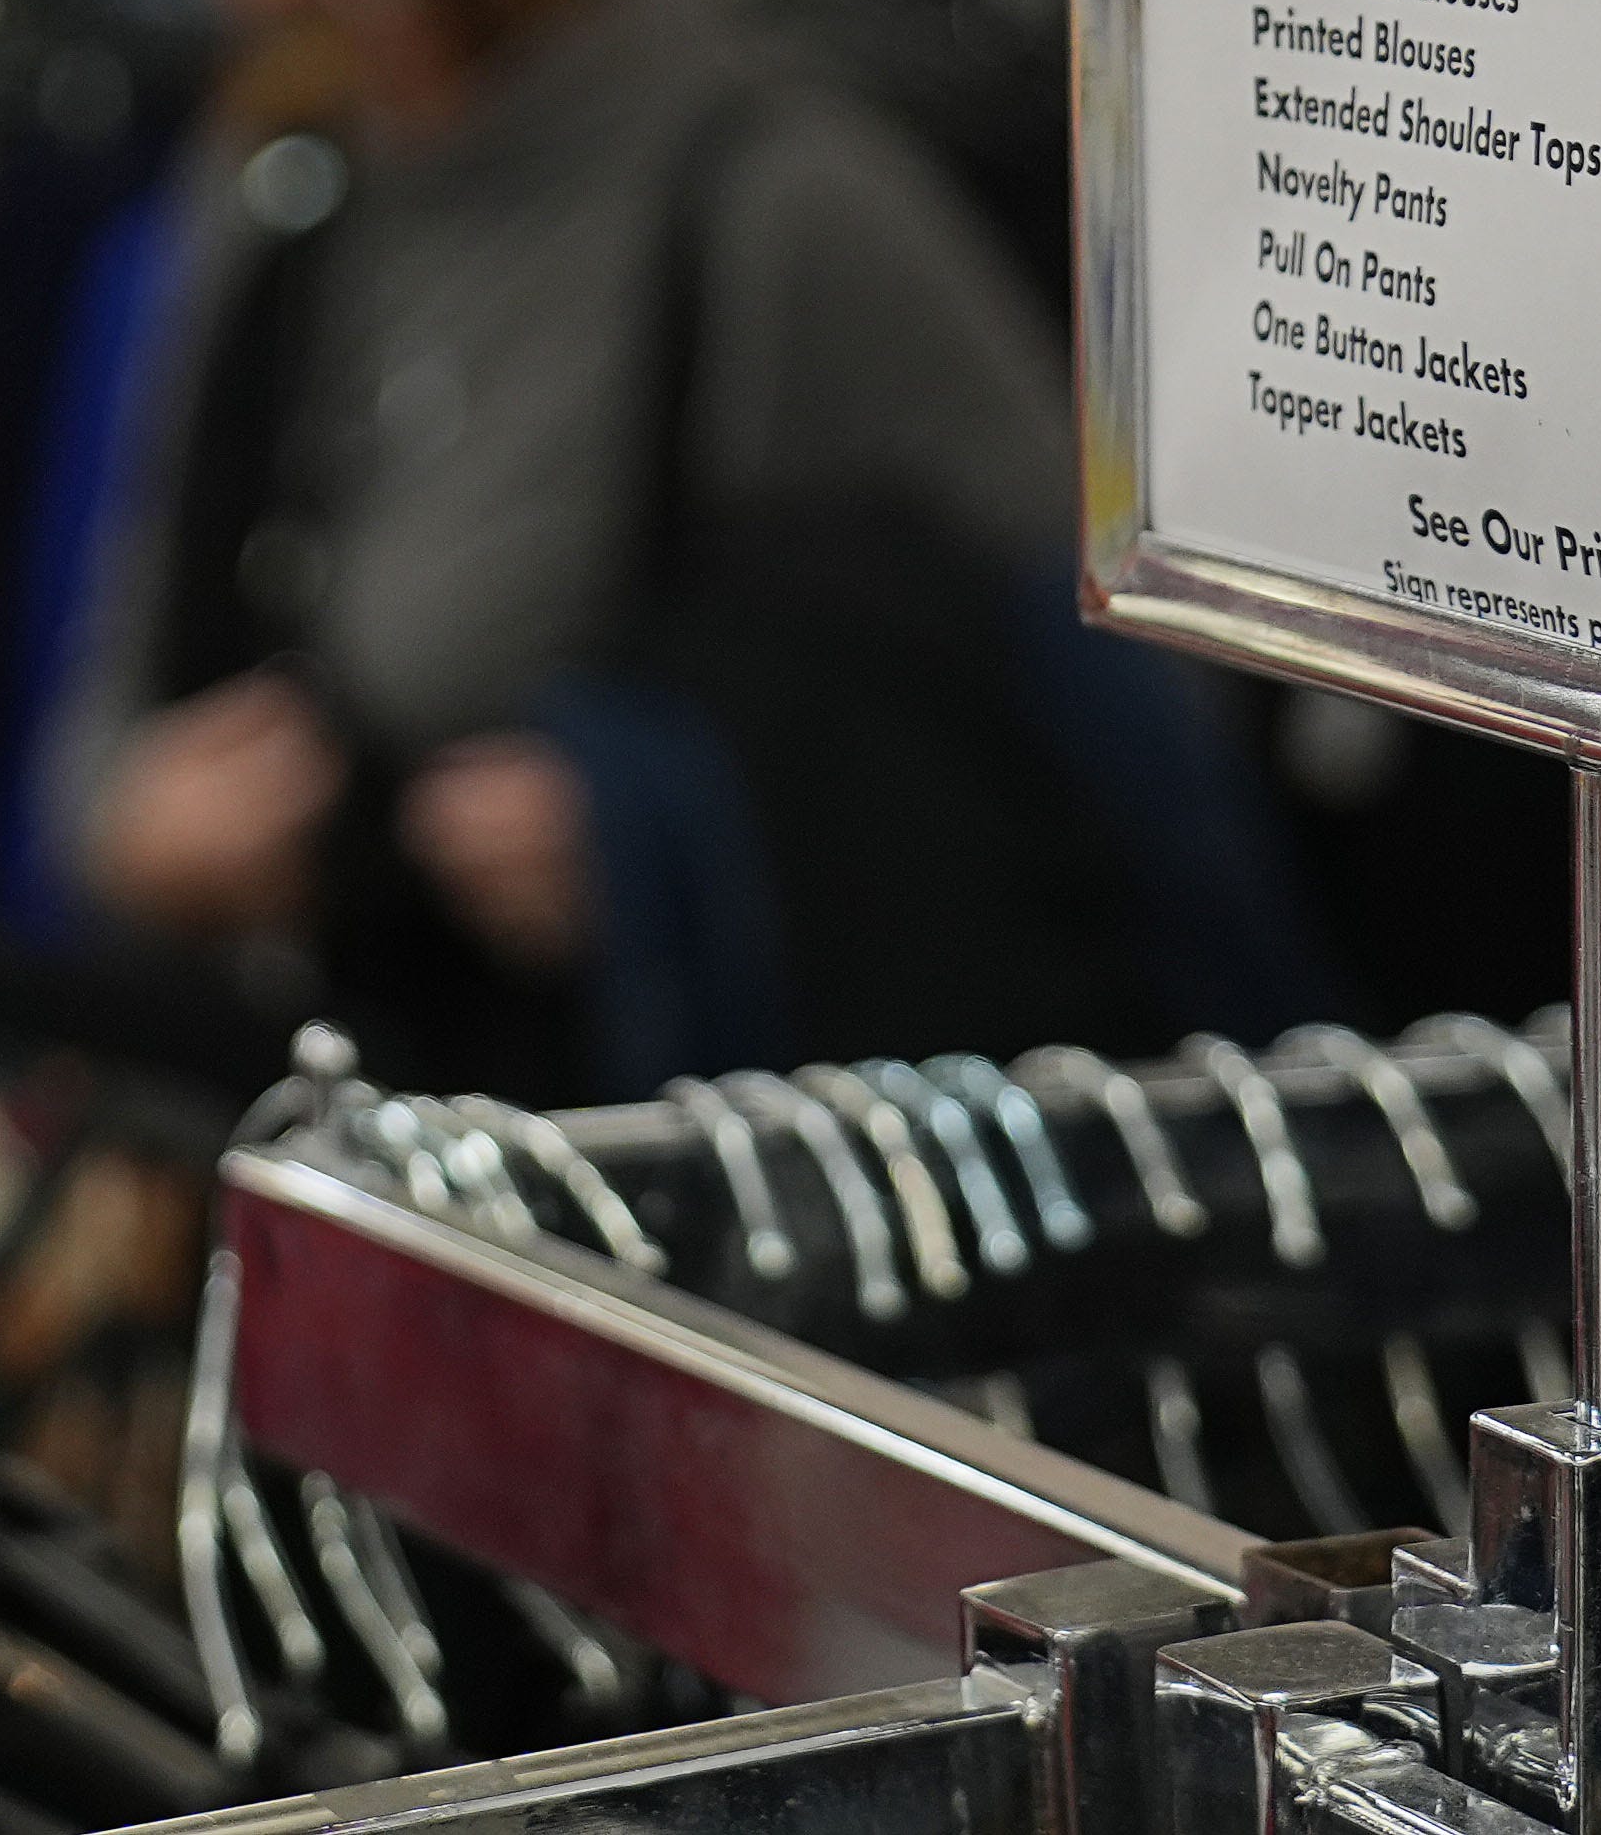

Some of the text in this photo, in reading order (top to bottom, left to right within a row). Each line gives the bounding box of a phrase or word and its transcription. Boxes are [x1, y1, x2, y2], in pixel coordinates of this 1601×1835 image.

[1254, 7, 1363, 59] Printed
[1375, 23, 1475, 78] Blouses
[1255, 77, 1390, 137] Extended
[1399, 99, 1520, 161] Shoulder
[1529, 121, 1601, 186] Tops
[1258, 151, 1365, 222] Novelty
[1374, 172, 1447, 227] Pants
[1259, 230, 1305, 277] Pull
[1316, 241, 1350, 288] On
[1362, 251, 1435, 306] Pants
[1254, 301, 1305, 350] One
[1316, 315, 1403, 373] Button
[1414, 336, 1527, 399] Jackets
[1248, 370, 1343, 434] Topper
[1354, 396, 1466, 458] Jackets
[1409, 494, 1470, 547] See
[1482, 509, 1544, 565] Our
[1383, 559, 1438, 605] Sign
[1445, 584, 1580, 638] represents
